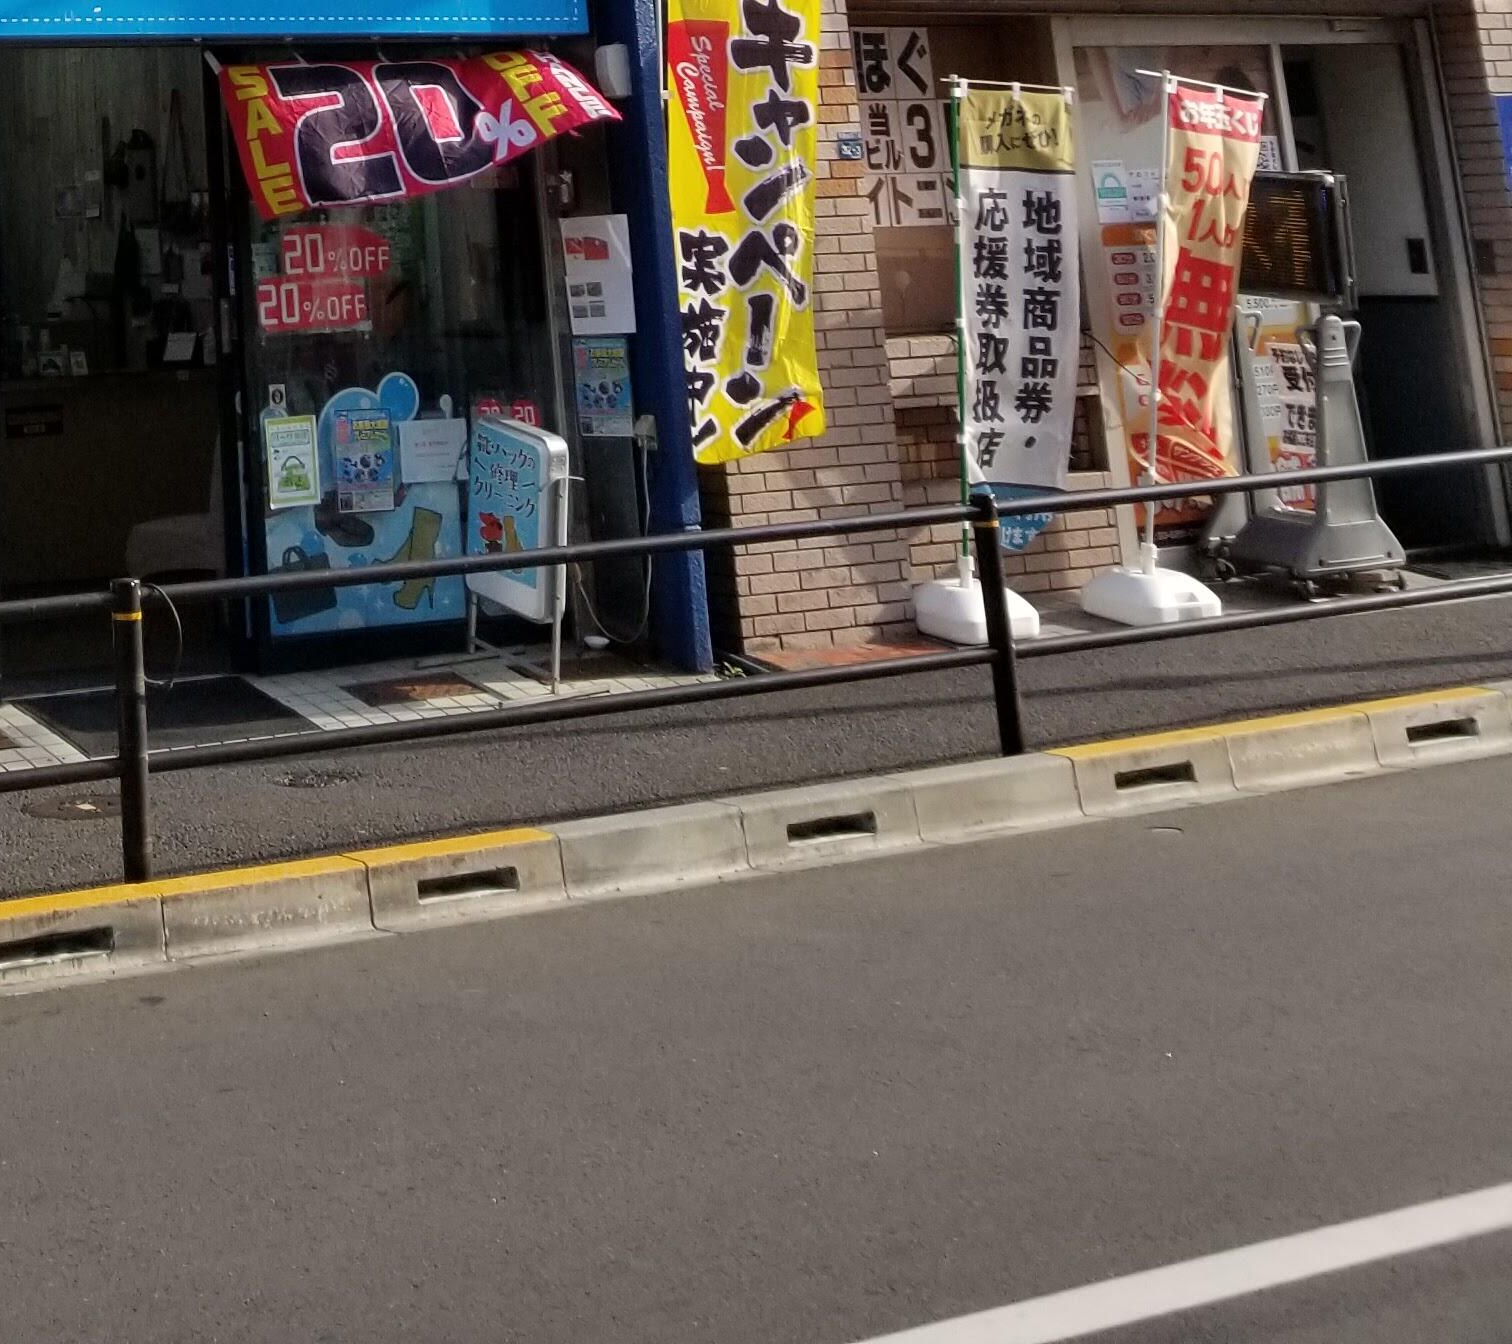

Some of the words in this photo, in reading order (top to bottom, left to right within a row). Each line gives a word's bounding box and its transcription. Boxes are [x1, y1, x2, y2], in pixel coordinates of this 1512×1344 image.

[482, 51, 569, 138] OFF
[690, 36, 725, 112] Special
[228, 66, 305, 215] SALE
[1179, 100, 1261, 138] お年玉くじ
